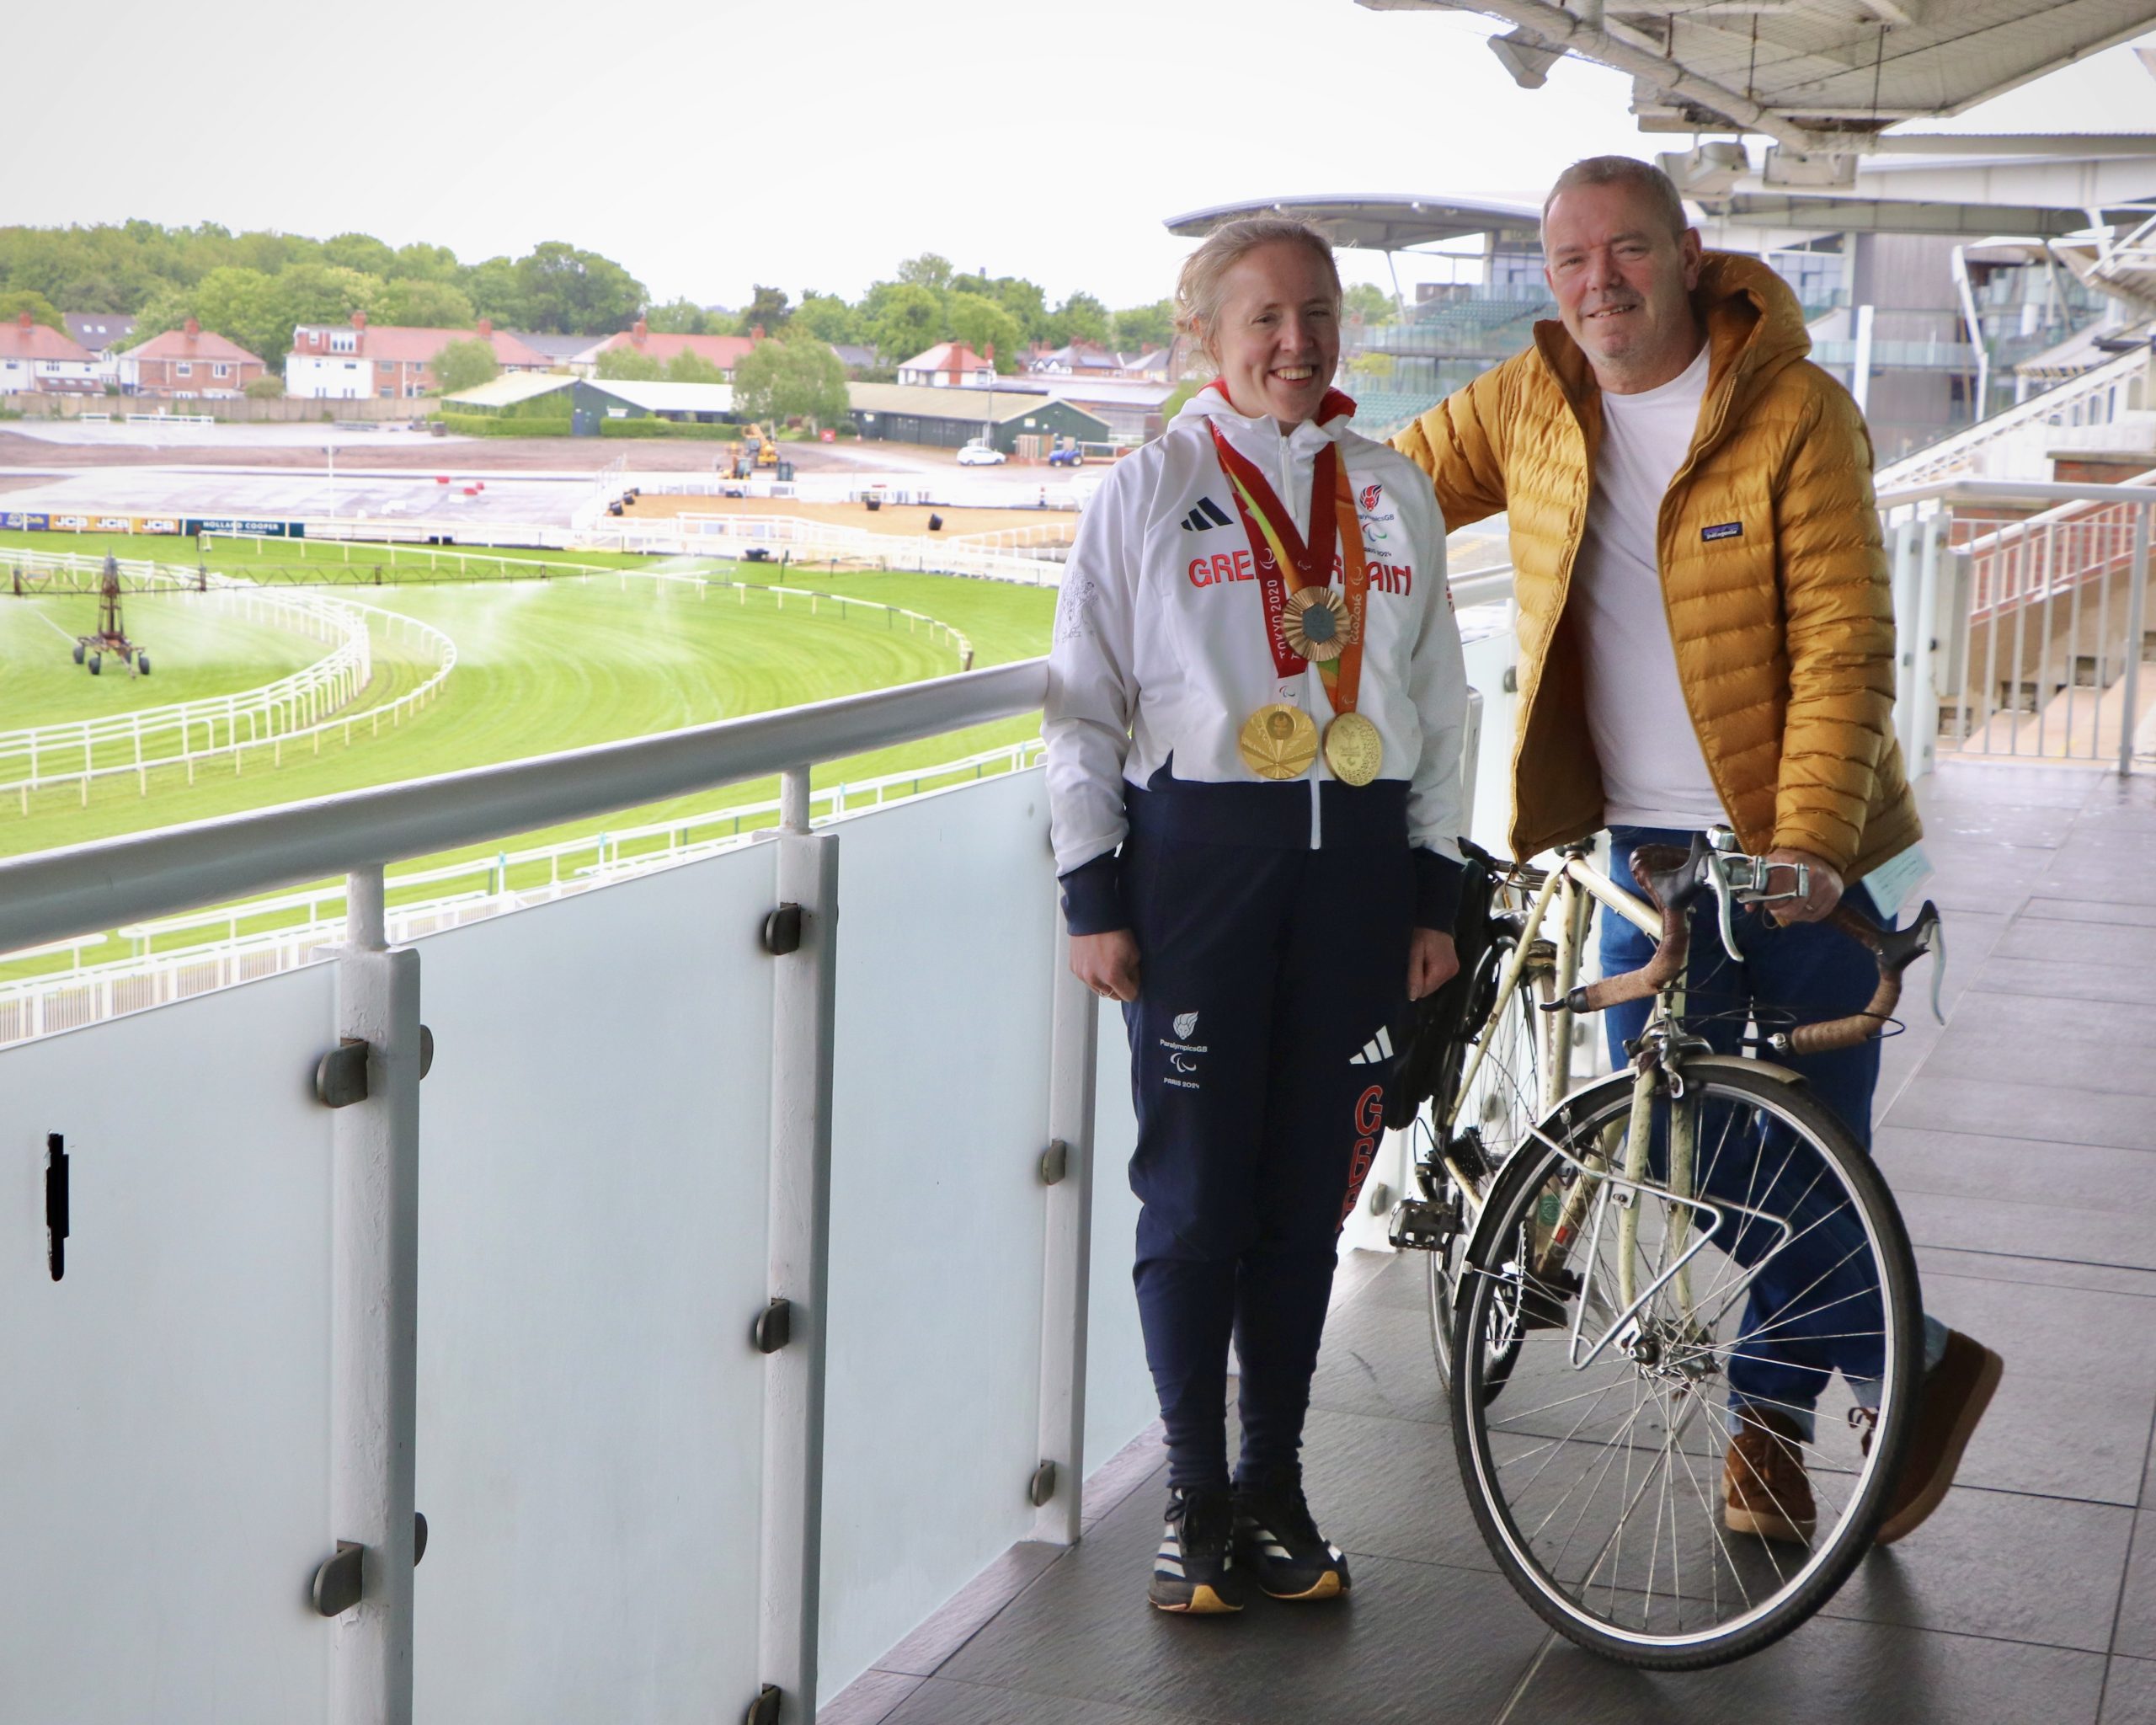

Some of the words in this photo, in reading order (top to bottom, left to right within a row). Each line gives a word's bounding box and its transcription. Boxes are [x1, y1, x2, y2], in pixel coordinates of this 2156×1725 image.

[55, 515, 88, 527] JCB
[96, 516, 130, 529] JCB
[141, 518, 175, 531] JCB
[244, 522, 279, 531] COOPER
[1188, 550, 1257, 588] GRE
[1267, 579, 1282, 612] 2020
[1160, 1038, 1208, 1053] ParalympicsGB
[1163, 1077, 1182, 1087] PARIS
[1182, 1081, 1200, 1089] 2024
